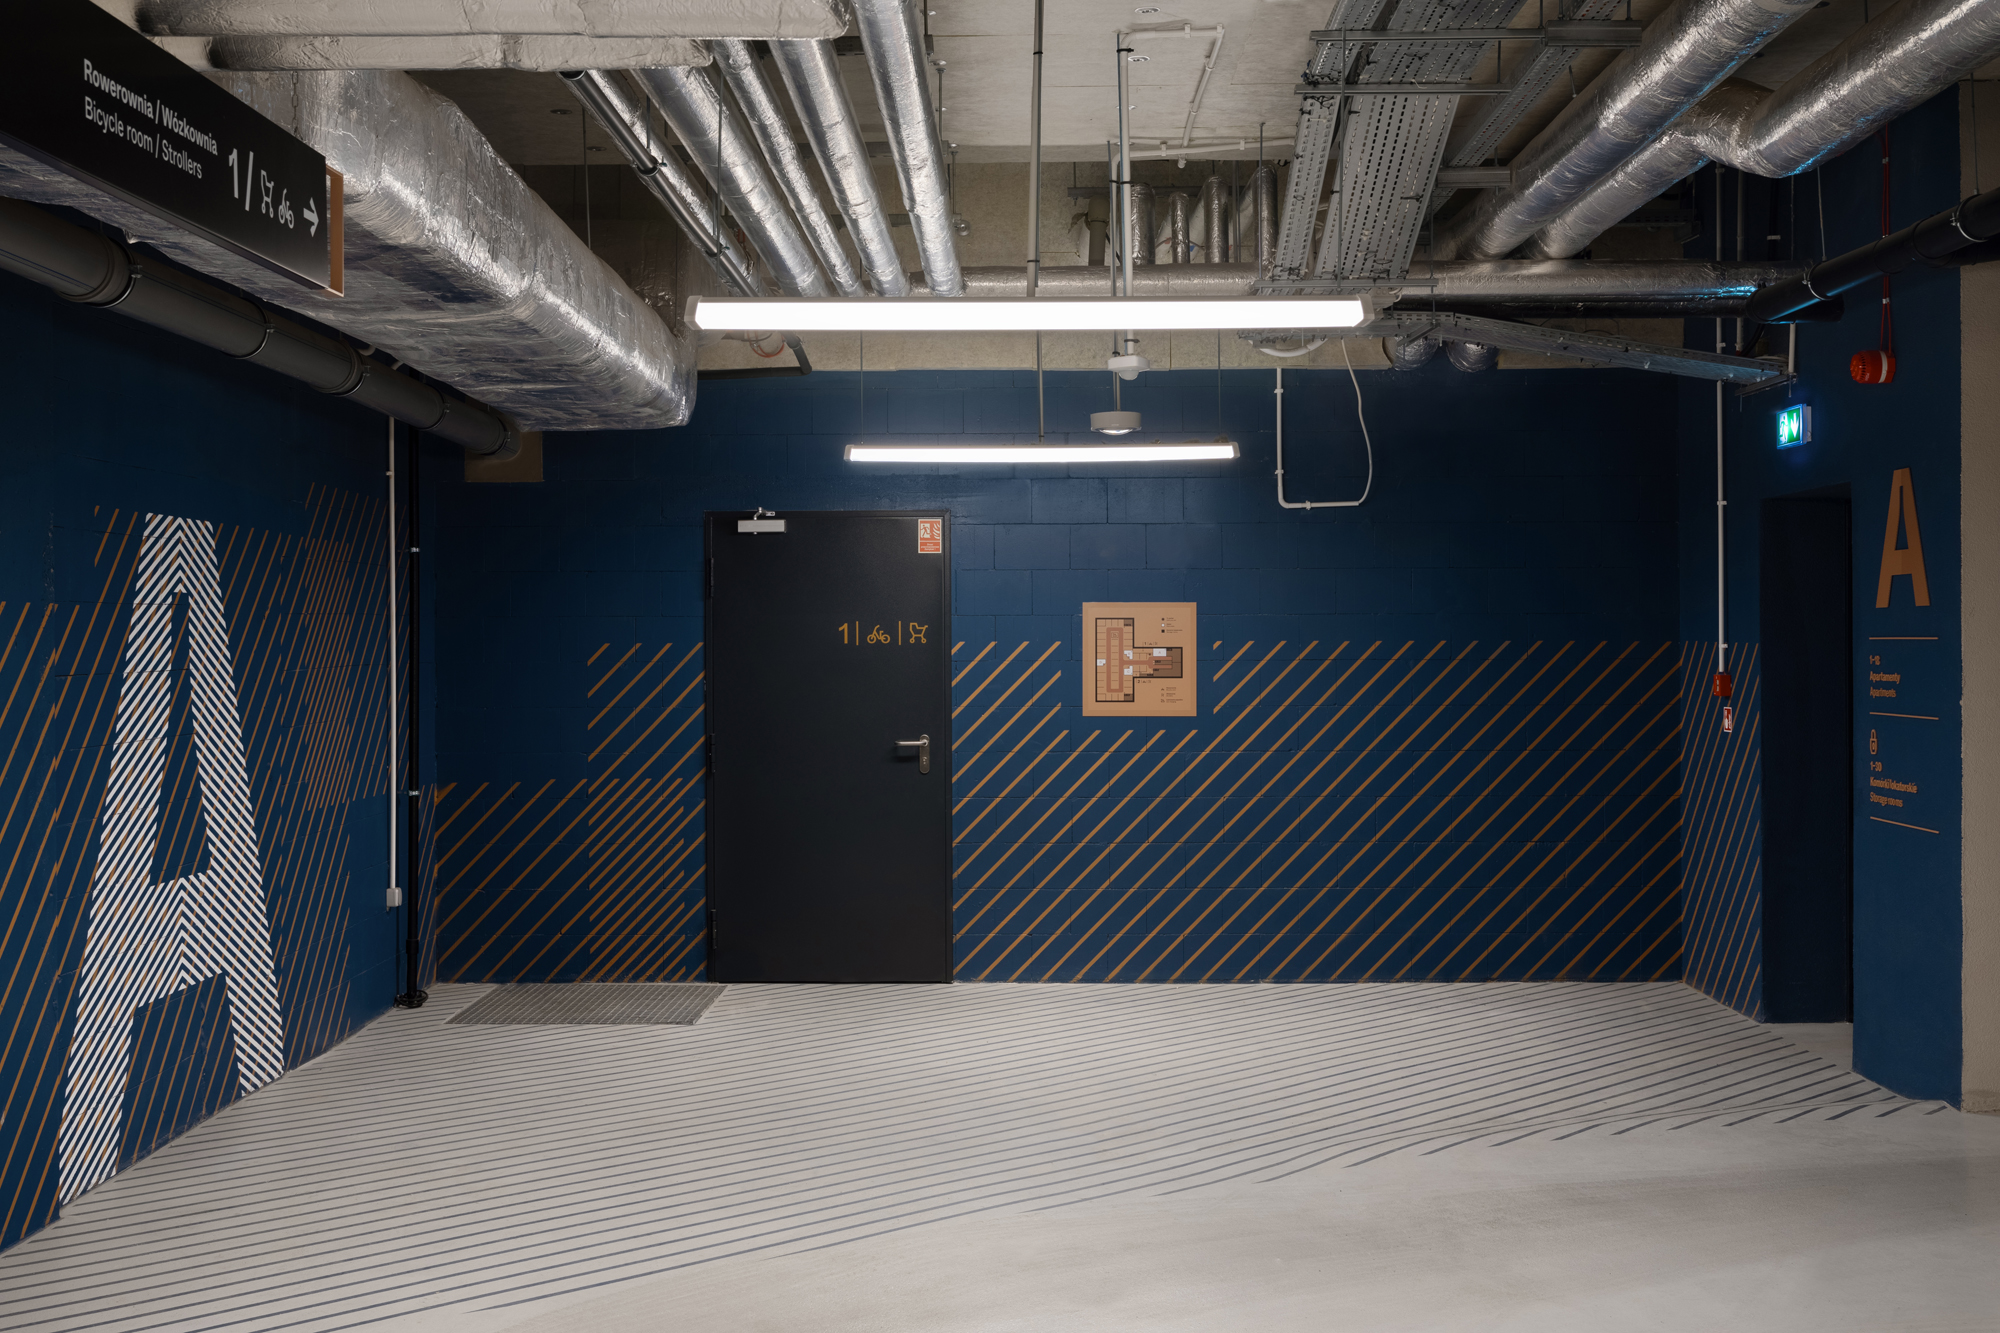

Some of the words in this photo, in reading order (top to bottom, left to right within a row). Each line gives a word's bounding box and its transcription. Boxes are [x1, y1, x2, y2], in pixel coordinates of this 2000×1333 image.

[84, 58, 154, 119] Rowerownia
[161, 104, 218, 156] Wózkownia
[85, 96, 124, 137] Bicycle
[126, 124, 153, 154] room
[162, 143, 202, 179] Strollers
[228, 148, 239, 199] 1
[1875, 467, 1931, 609] A
[838, 622, 848, 644] 1
[1869, 670, 1901, 685] Apartamenty
[1869, 686, 1897, 699] Apartments
[1869, 791, 1887, 807] Storage
[1887, 797, 1904, 808] rooms
[59, 512, 285, 1206] A
